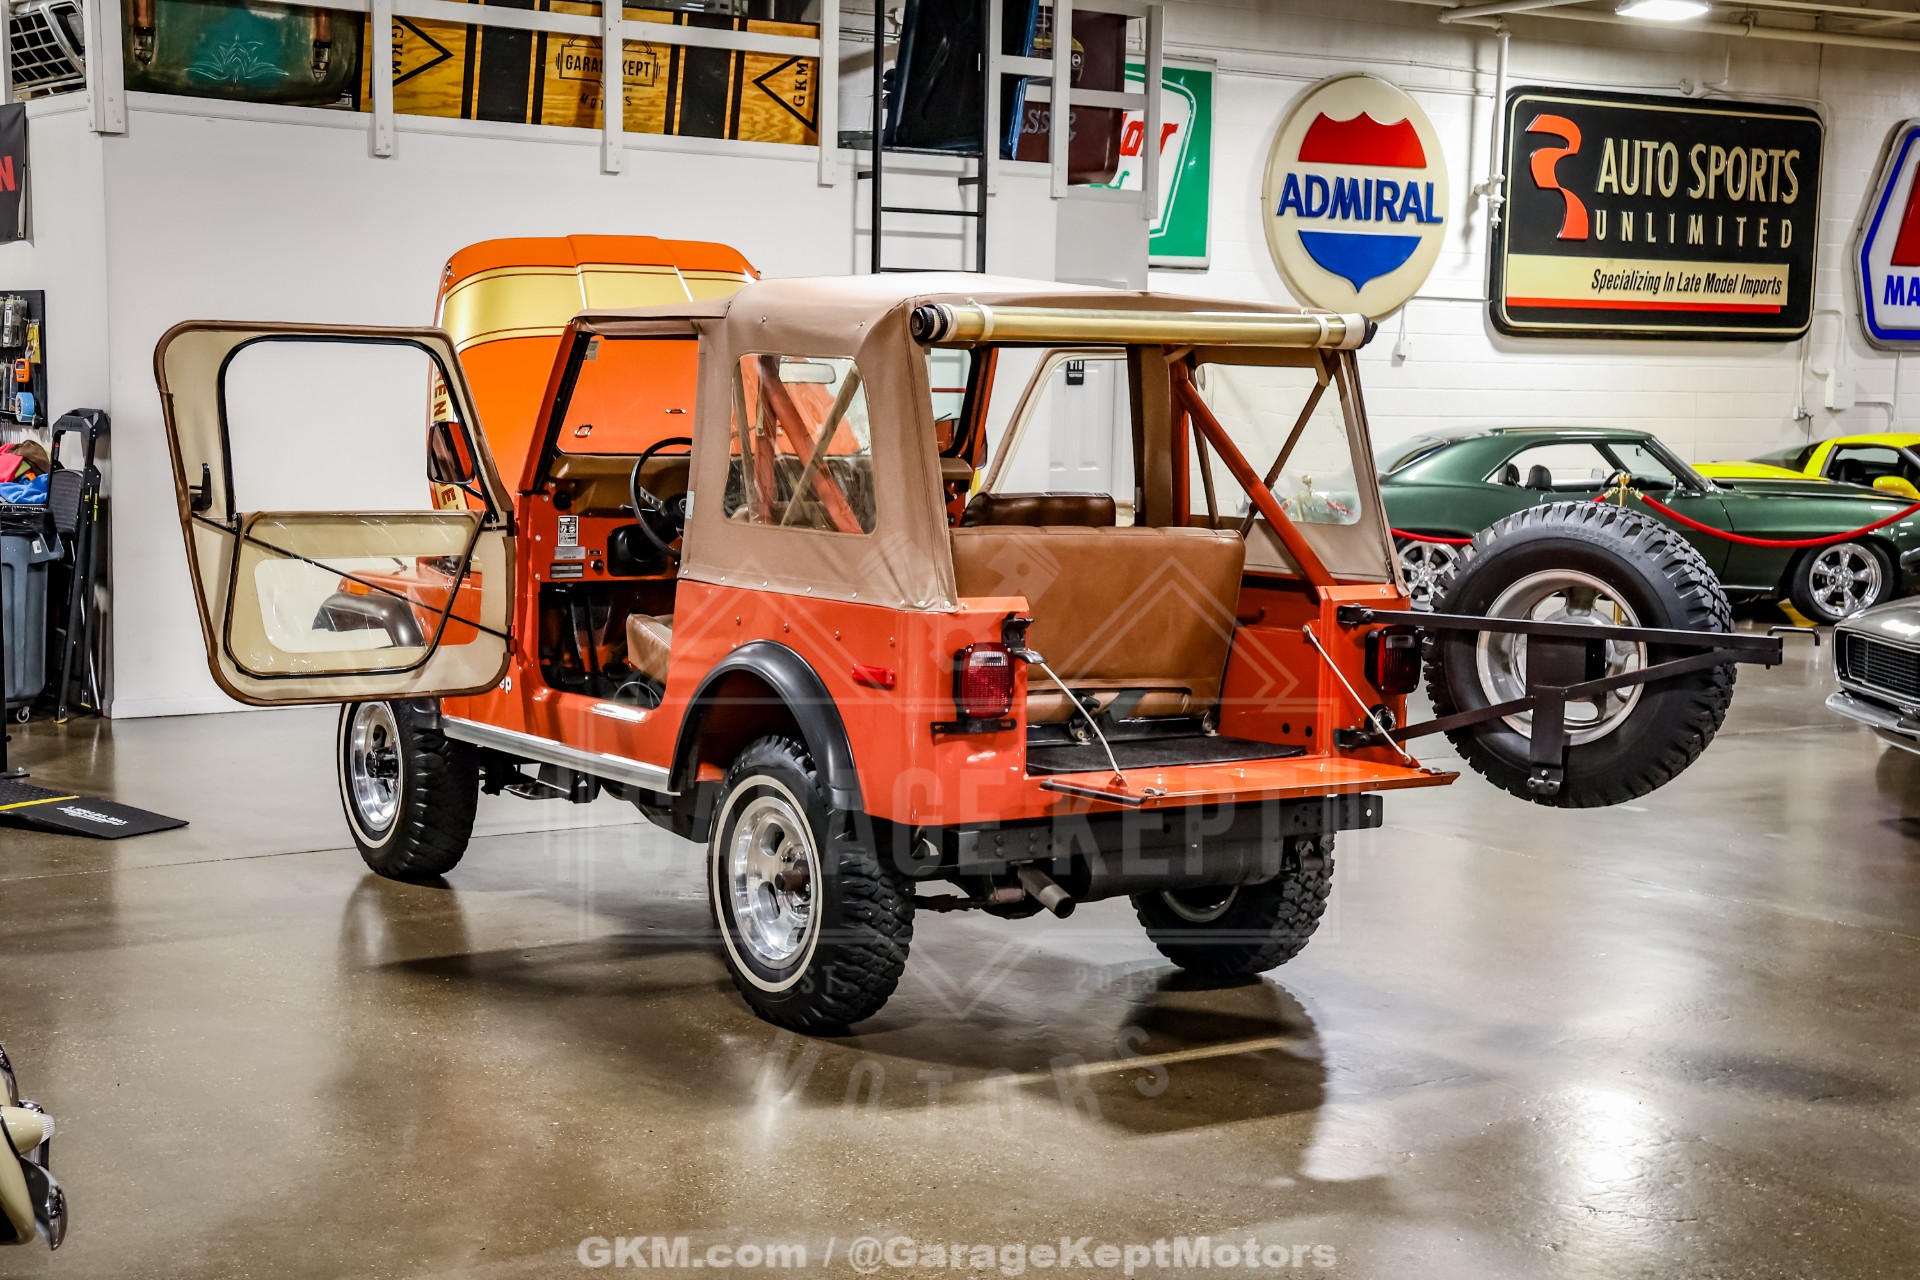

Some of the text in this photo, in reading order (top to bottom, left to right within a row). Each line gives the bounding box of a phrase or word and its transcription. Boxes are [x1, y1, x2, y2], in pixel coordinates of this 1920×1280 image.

[392, 25, 404, 75] GKM
[565, 55, 603, 73] GARA
[793, 62, 809, 107] GKM
[1596, 137, 1800, 204] AUTO SPORTS
[1276, 173, 1444, 223] ADMIRAL
[1595, 209, 1793, 249] UNLIMITED
[1592, 268, 1782, 297] Specializing In Late Model Imports
